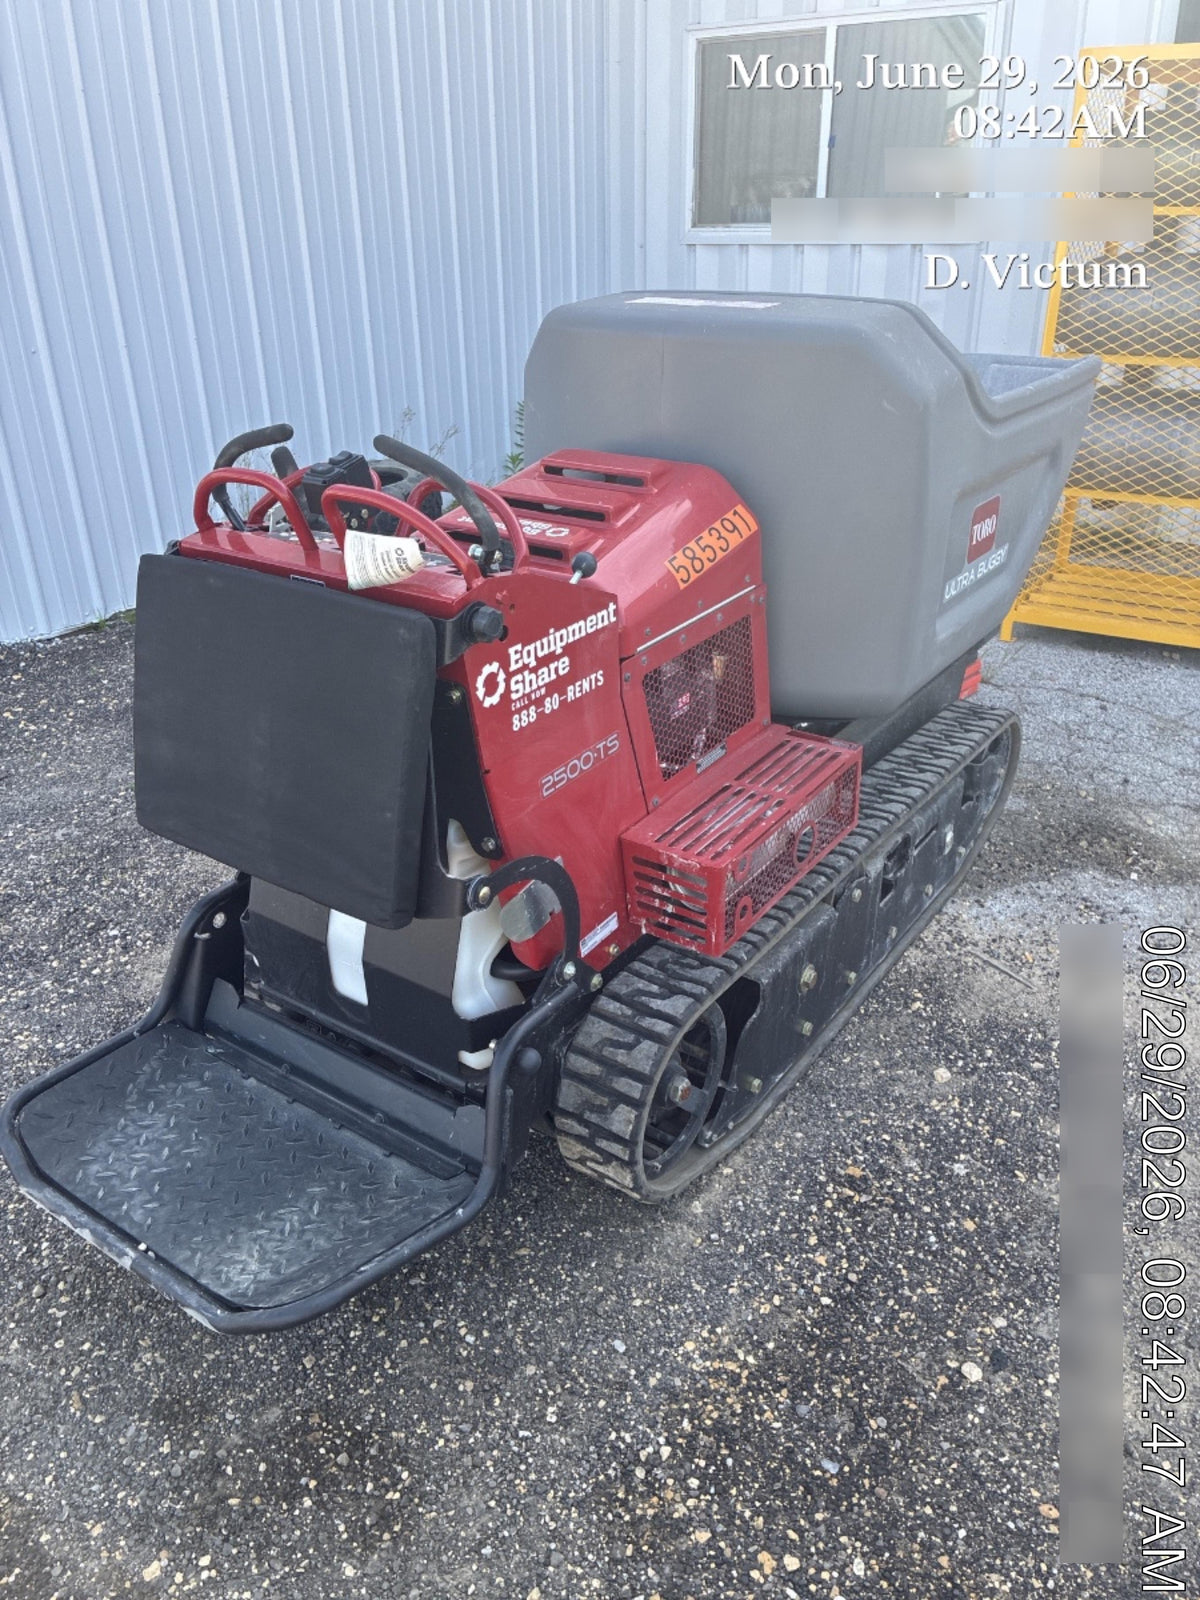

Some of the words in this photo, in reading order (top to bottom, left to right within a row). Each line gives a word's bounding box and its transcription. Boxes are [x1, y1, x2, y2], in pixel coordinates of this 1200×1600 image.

[667, 508, 752, 585] 585391
[971, 513, 997, 546] TORO
[944, 567, 976, 600] ULTRA
[976, 542, 1009, 579] BUGGY
[508, 601, 617, 672] Equipment
[510, 656, 570, 700] Share
[511, 696, 529, 711] CALL
[531, 687, 547, 701] NOW
[512, 670, 604, 731] 888-80-RENTS
